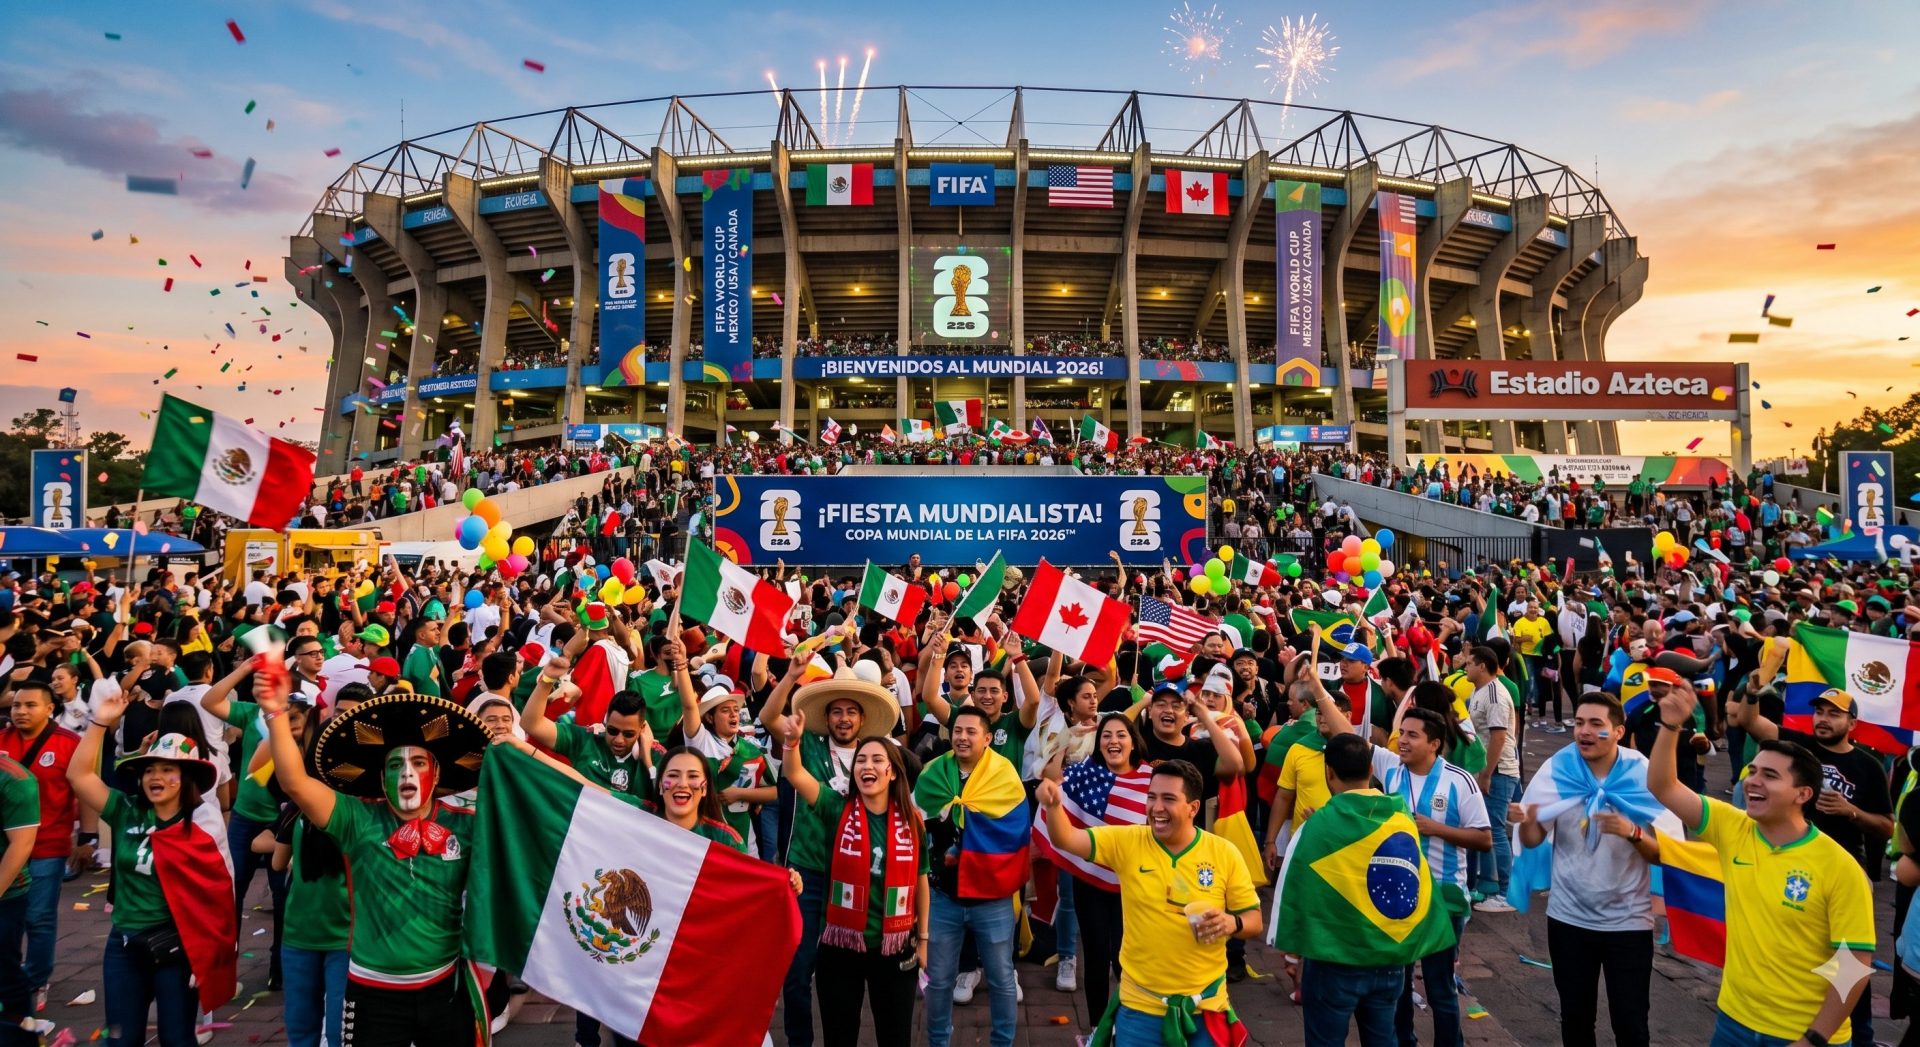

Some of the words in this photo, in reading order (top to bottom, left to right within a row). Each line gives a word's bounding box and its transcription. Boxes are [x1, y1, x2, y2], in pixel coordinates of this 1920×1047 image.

[937, 176, 987, 194] FIFA
[715, 225, 726, 251] CUP
[728, 208, 739, 259] CANADA
[1289, 230, 1300, 256] CUP
[1302, 220, 1312, 267] CANADA
[715, 253, 726, 302] WORLD
[728, 267, 739, 290] USA
[1289, 258, 1300, 305] WORLD
[1302, 275, 1312, 297] USA
[715, 303, 726, 333] FIFA
[728, 299, 739, 344] MEXICO
[946, 321, 975, 330] 226
[1289, 306, 1300, 335] FIFA
[1302, 304, 1312, 347] MEXICO
[821, 360, 943, 378] ¡BIENVENIDOS
[946, 360, 970, 374] AL
[973, 360, 1053, 374] MUNDIAL
[1056, 361, 1104, 376] 2026!
[1490, 370, 1601, 395] Estadio
[1607, 372, 1709, 396] Azteca
[818, 503, 913, 528] ¡FIESTA
[919, 503, 1102, 523] MUNDIALISTA!
[845, 529, 884, 541] COPA
[886, 529, 952, 541] MUNDIAL
[955, 529, 974, 541] DE
[977, 529, 995, 541] LA
[998, 529, 1028, 541] FIFA
